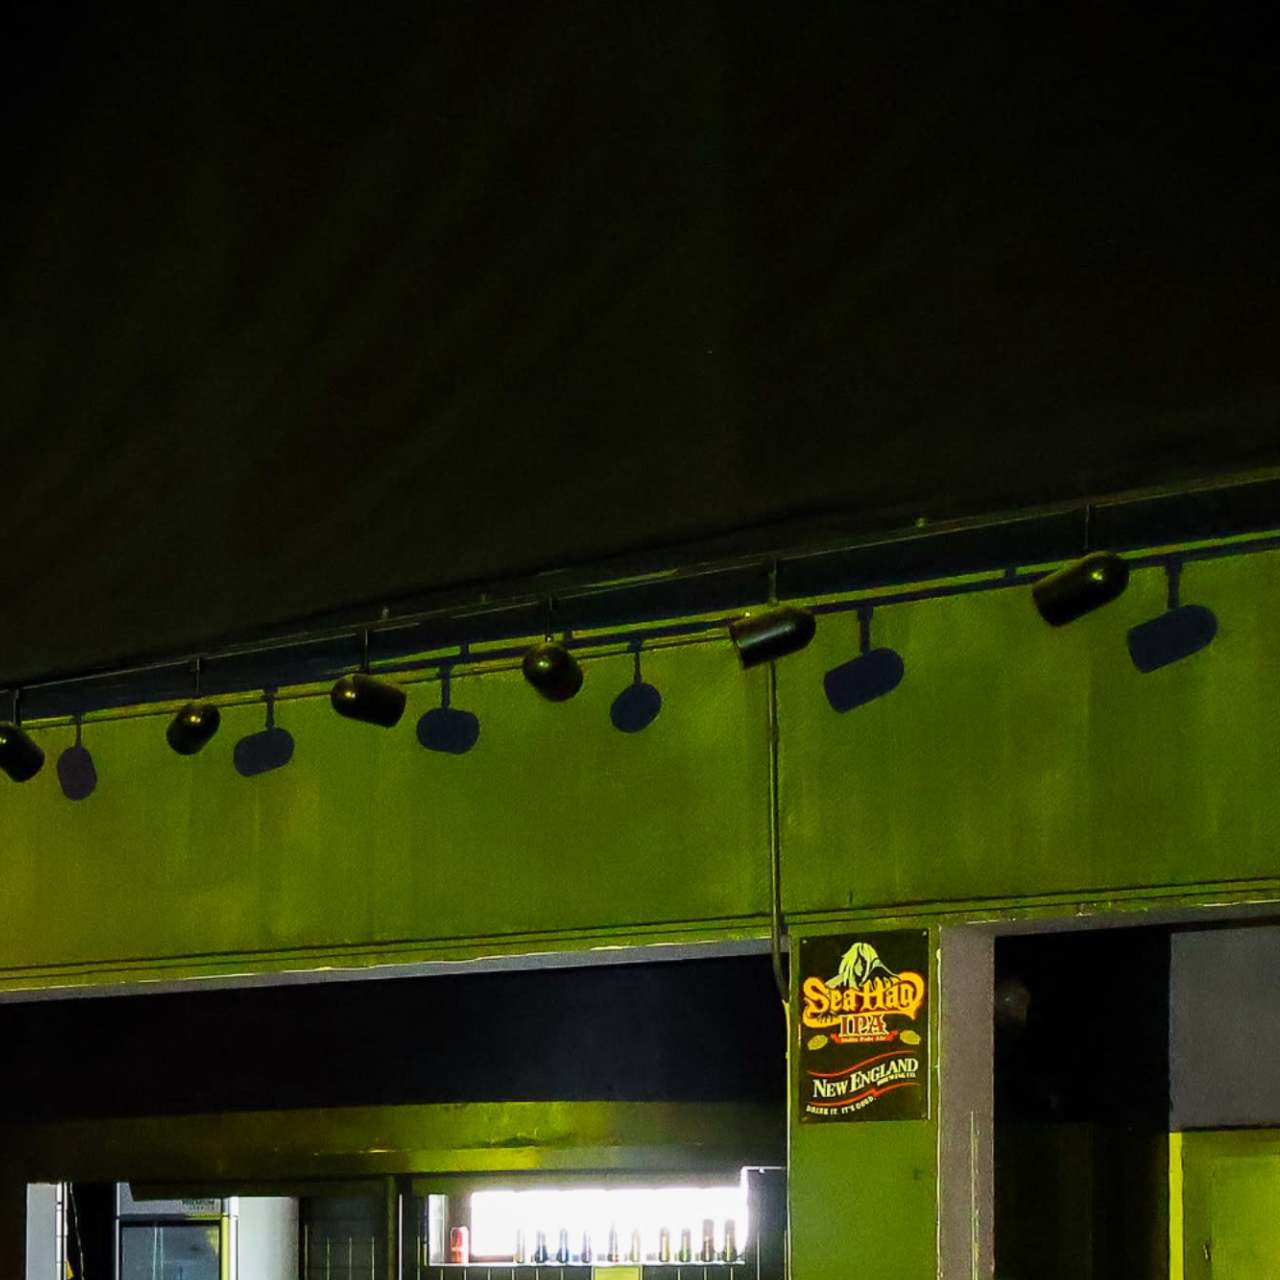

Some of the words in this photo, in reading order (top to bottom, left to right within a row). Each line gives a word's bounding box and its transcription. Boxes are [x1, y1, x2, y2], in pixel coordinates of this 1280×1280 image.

[803, 977, 858, 1018] Sea
[839, 1014, 889, 1036] IPA
[813, 1079, 848, 1098] NEW
[849, 1058, 919, 1093] ENGLAND
